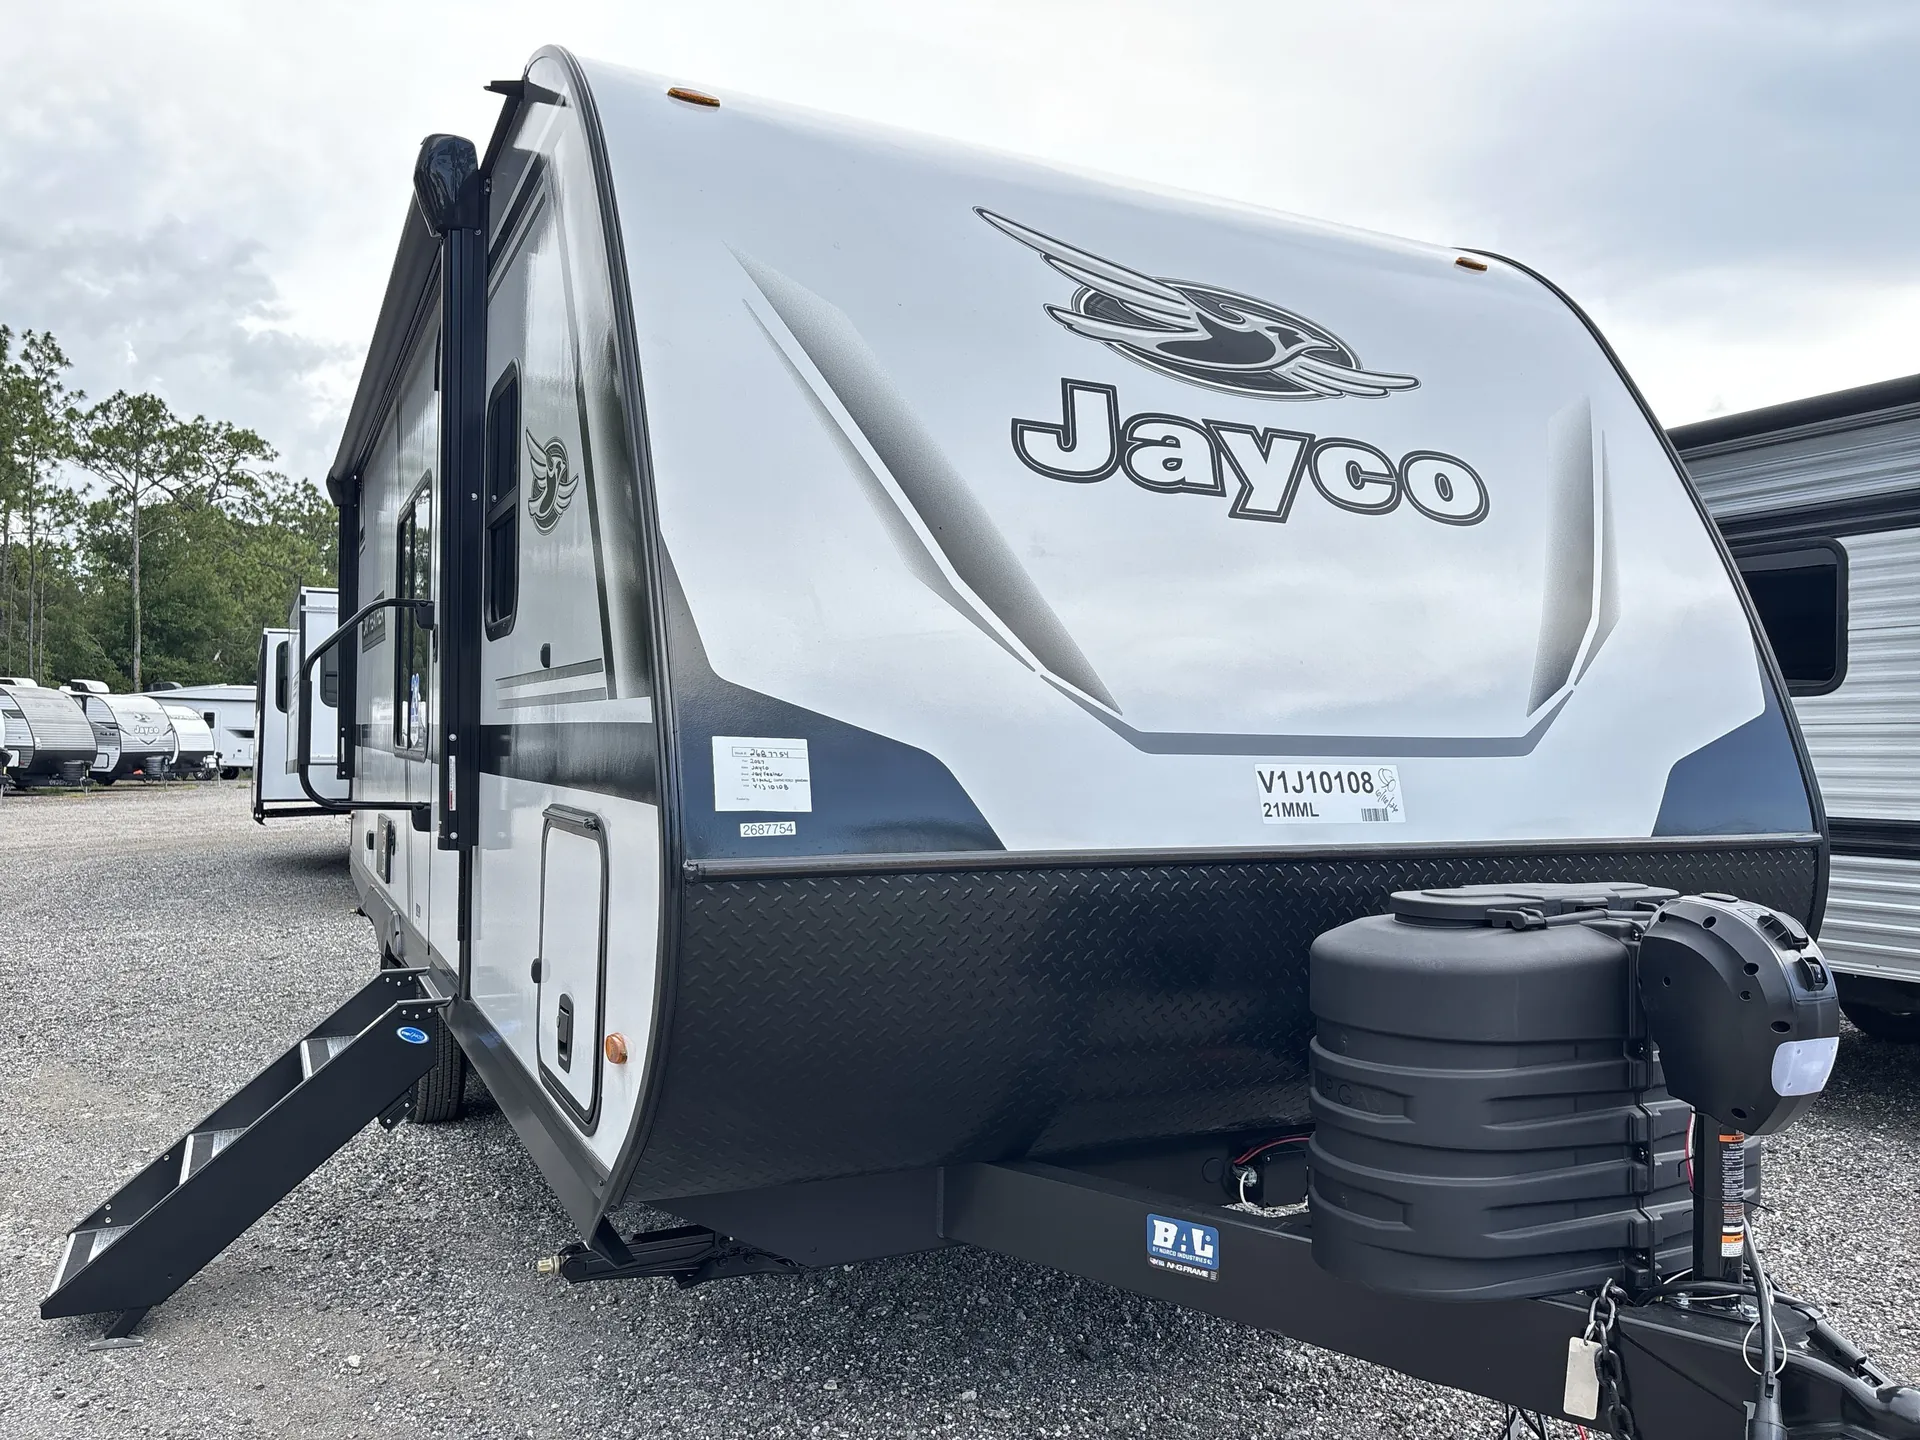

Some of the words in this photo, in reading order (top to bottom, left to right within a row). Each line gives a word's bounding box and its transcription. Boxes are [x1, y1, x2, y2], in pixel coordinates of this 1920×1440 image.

[1011, 377, 1491, 527] Jayco
[134, 725, 159, 735] Jayco
[749, 748, 789, 758] 2687754
[1257, 770, 1374, 794] V1J10108
[1263, 802, 1320, 817] 21MML
[743, 823, 793, 836] 2687754
[1183, 1266, 1209, 1278] FRAME
